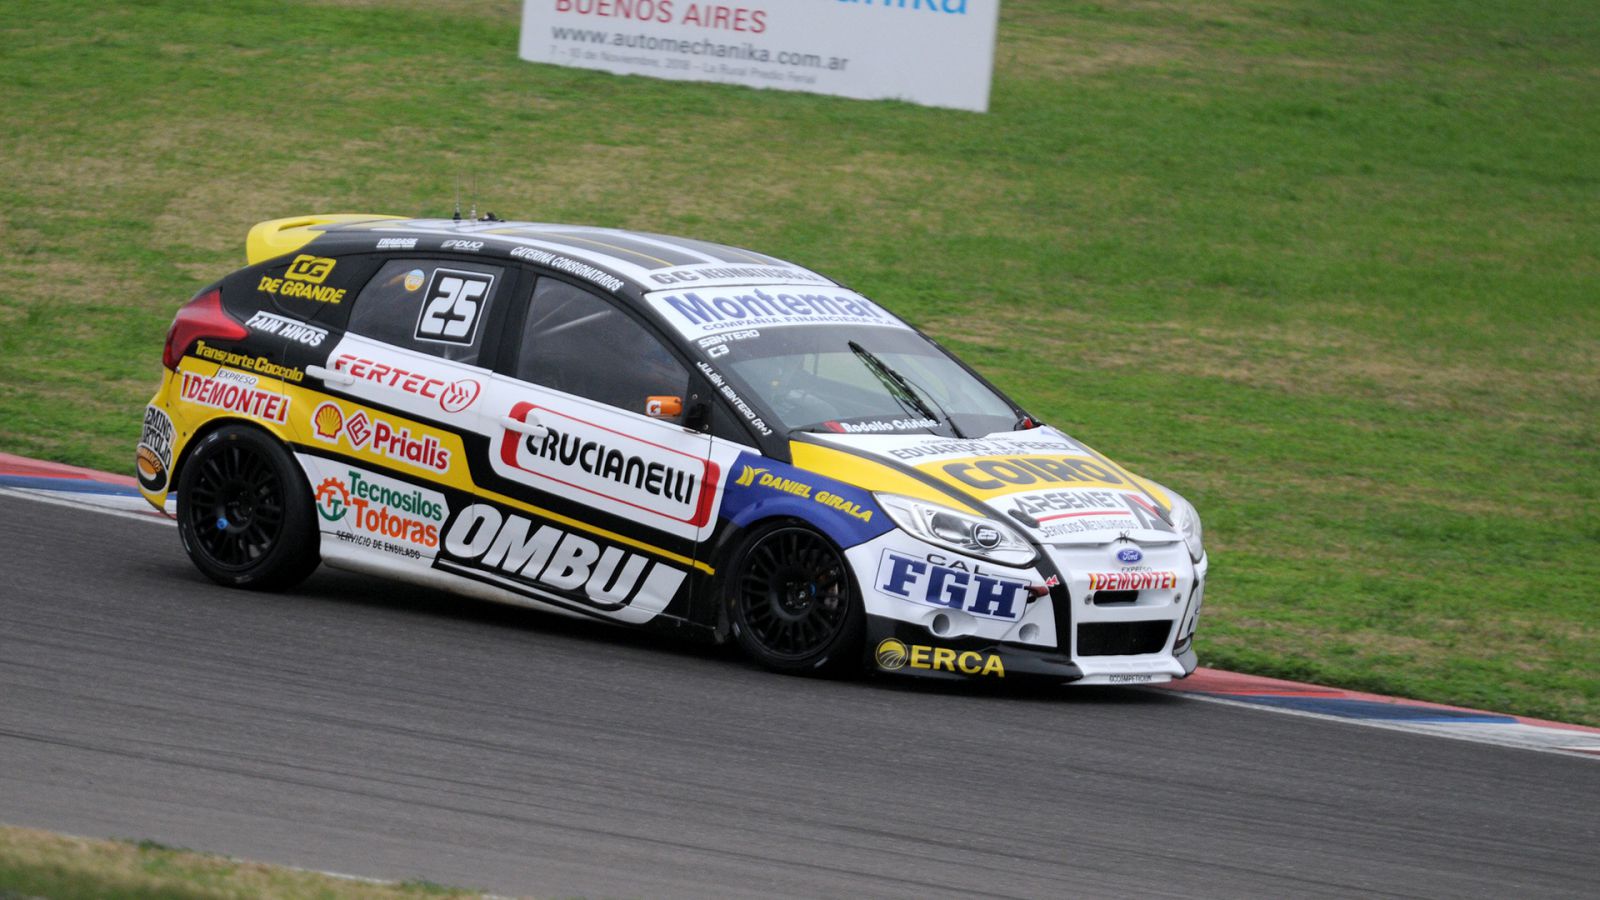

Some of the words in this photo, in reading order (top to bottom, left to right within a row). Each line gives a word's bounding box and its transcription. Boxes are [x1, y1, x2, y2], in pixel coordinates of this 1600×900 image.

[555, 0, 674, 24] BUENOS
[681, 3, 767, 33] AIRES
[551, 26, 849, 71] www.automechanika.com.ar
[257, 275, 283, 293] DE
[280, 280, 347, 305] GRANDE
[649, 270, 700, 285] GC
[421, 277, 487, 337] 25
[662, 287, 885, 326] Montemar
[784, 315, 869, 326] FINANCIERA
[279, 322, 329, 347] HNOS
[195, 340, 255, 370] Transporte
[254, 356, 304, 382] Coccolo
[335, 353, 445, 399] FERTEC
[218, 369, 257, 386] EXPRESO
[187, 376, 281, 419] DEMONTE
[841, 420, 894, 433] Rodolfo
[374, 422, 449, 471] Prialis
[889, 441, 988, 460] EDUARDO
[942, 458, 1123, 490] COIRO
[348, 470, 443, 522] Tecnosilos
[759, 473, 813, 499] DANIEL
[814, 491, 874, 523] GIRALA
[1013, 491, 1124, 514] ARSEMET
[352, 497, 438, 548] Totoras
[977, 528, 998, 541] 25
[336, 530, 372, 547] SERVICIO
[372, 539, 382, 551] DE
[445, 503, 650, 605] OMBU
[1121, 550, 1139, 562] Ford
[926, 553, 990, 577] CAL
[1094, 572, 1172, 590] DEMONTE
[883, 554, 1023, 619] FGH
[910, 644, 1006, 678] ERCA
